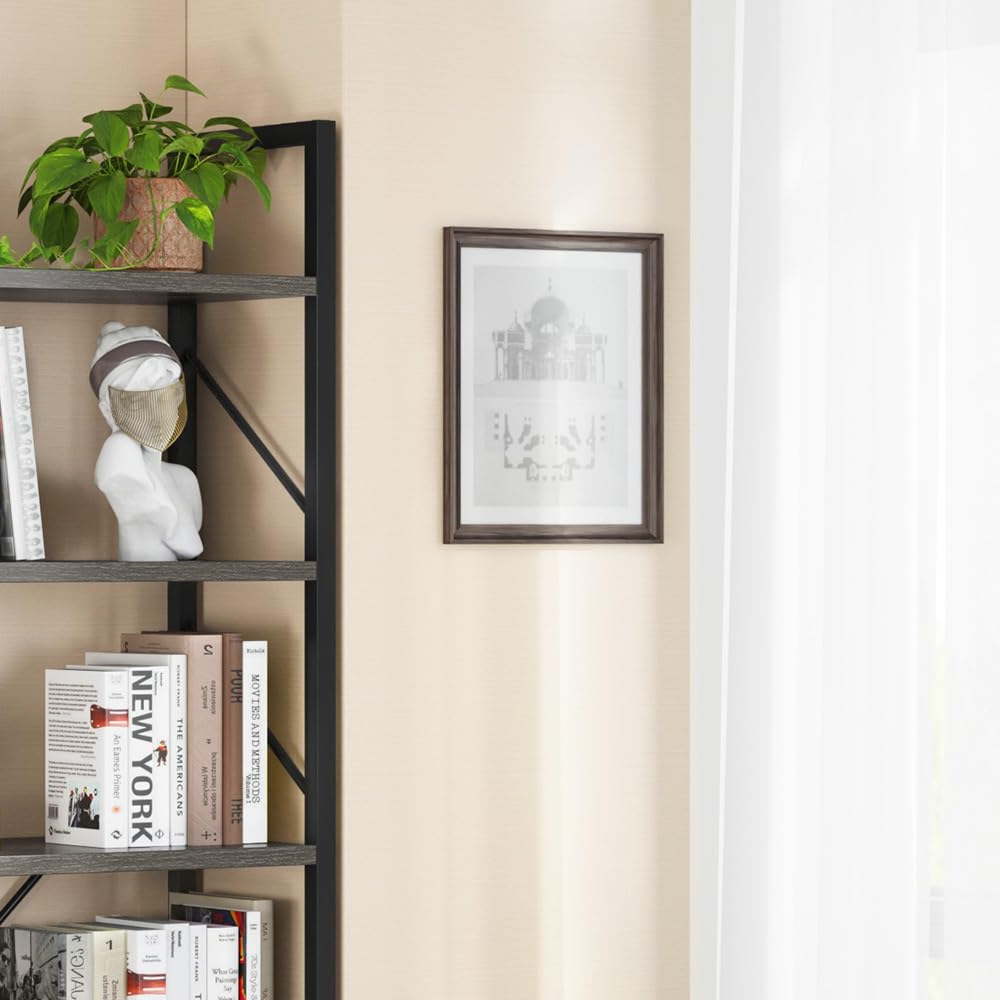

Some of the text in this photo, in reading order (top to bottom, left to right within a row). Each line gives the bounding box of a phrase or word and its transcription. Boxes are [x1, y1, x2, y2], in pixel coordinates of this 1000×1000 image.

[113, 747, 121, 773] Eames
[131, 670, 153, 843] NEW YORK
[176, 718, 184, 817] THE AMERICANS
[251, 674, 261, 804] MOVIES AND METHODS
[113, 774, 122, 800] Primer
[105, 939, 113, 951] 1
